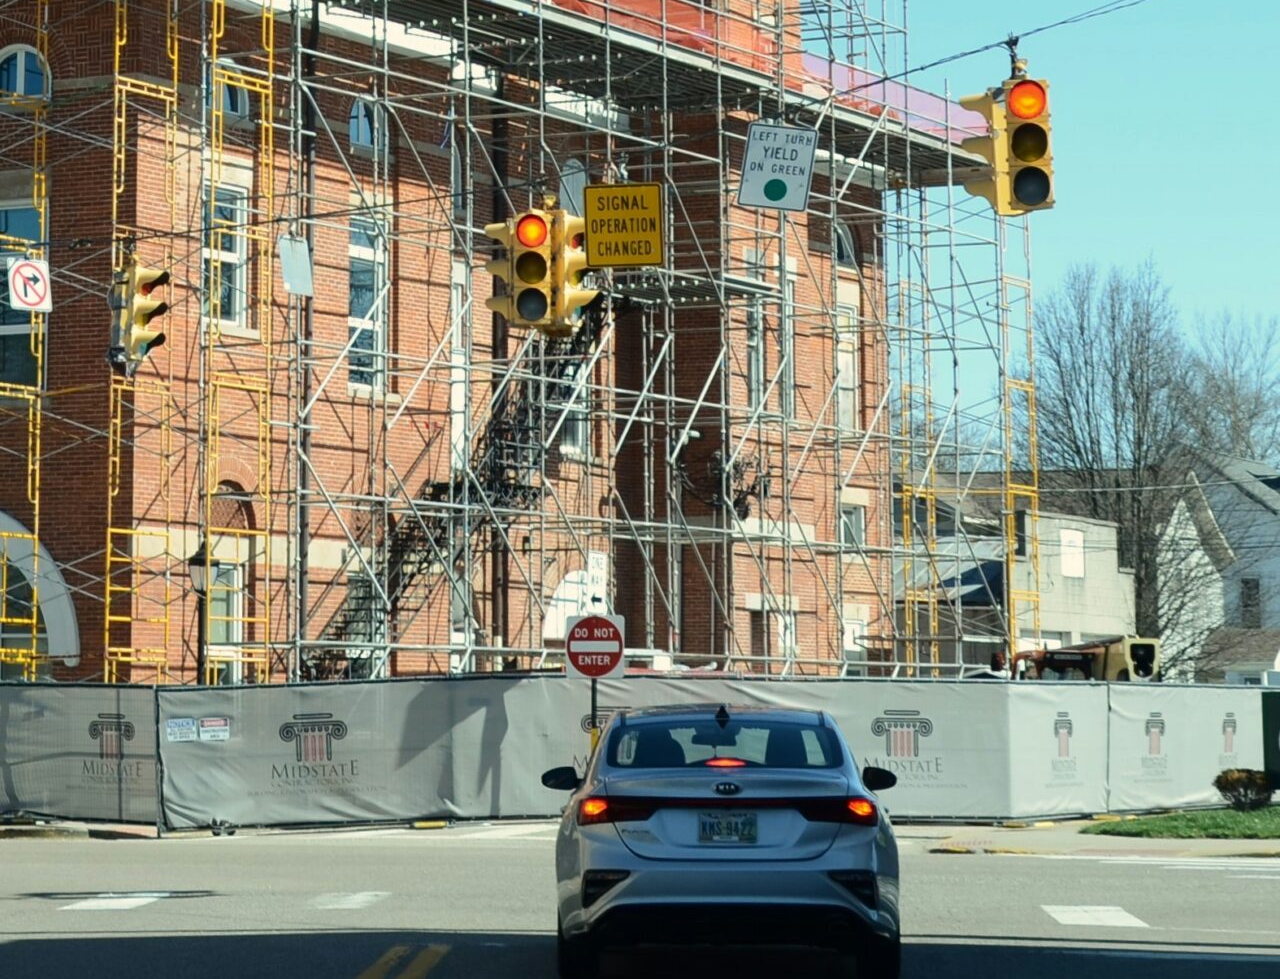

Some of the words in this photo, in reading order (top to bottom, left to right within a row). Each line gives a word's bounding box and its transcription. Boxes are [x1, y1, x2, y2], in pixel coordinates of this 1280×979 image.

[752, 131, 778, 141] LEFT
[785, 134, 813, 146] TURN
[763, 146, 799, 161] YIELD
[750, 162, 764, 172] ON
[771, 164, 806, 177] GREEN
[597, 195, 649, 211] SIGNAL
[591, 217, 657, 234] OPERATION
[597, 240, 652, 257] CHANGED
[574, 627, 589, 638] DO
[594, 627, 615, 638] NOT
[578, 655, 611, 666] ENTER
[81, 760, 143, 778] MIDSTATE
[271, 759, 360, 780] MIDSTATE
